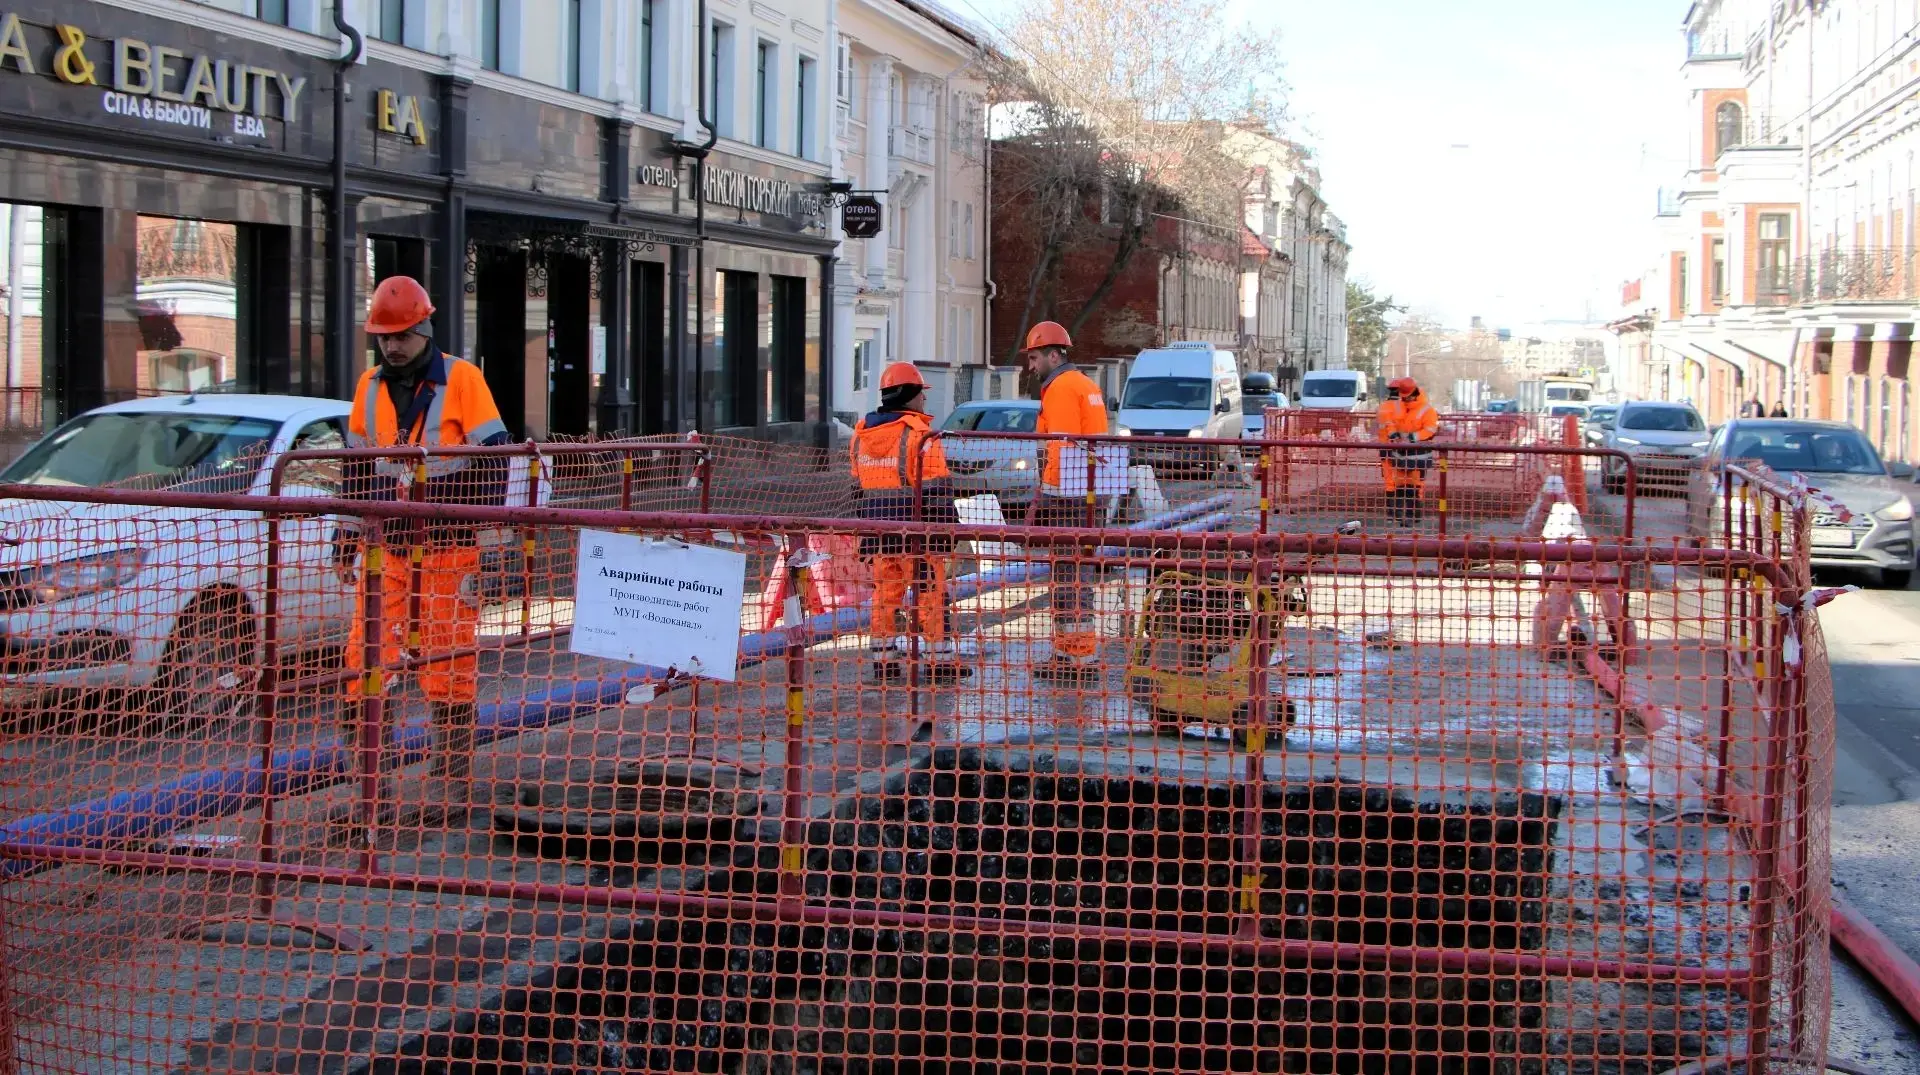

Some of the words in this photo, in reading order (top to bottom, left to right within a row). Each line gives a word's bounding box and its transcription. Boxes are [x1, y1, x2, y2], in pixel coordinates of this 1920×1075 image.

[53, 24, 98, 85] &
[113, 37, 308, 123] BEAUTY
[234, 114, 265, 138] Е.ВА
[642, 165, 679, 189] отель
[748, 176, 791, 218] ГОРЬКИЙ
[846, 205, 877, 214] отель
[599, 566, 674, 587] Аварийные
[678, 580, 723, 596] работы
[609, 587, 682, 608] Производитель
[683, 601, 711, 614] работ
[613, 606, 640, 620] МУП
[642, 609, 702, 630] «Водоканал»
